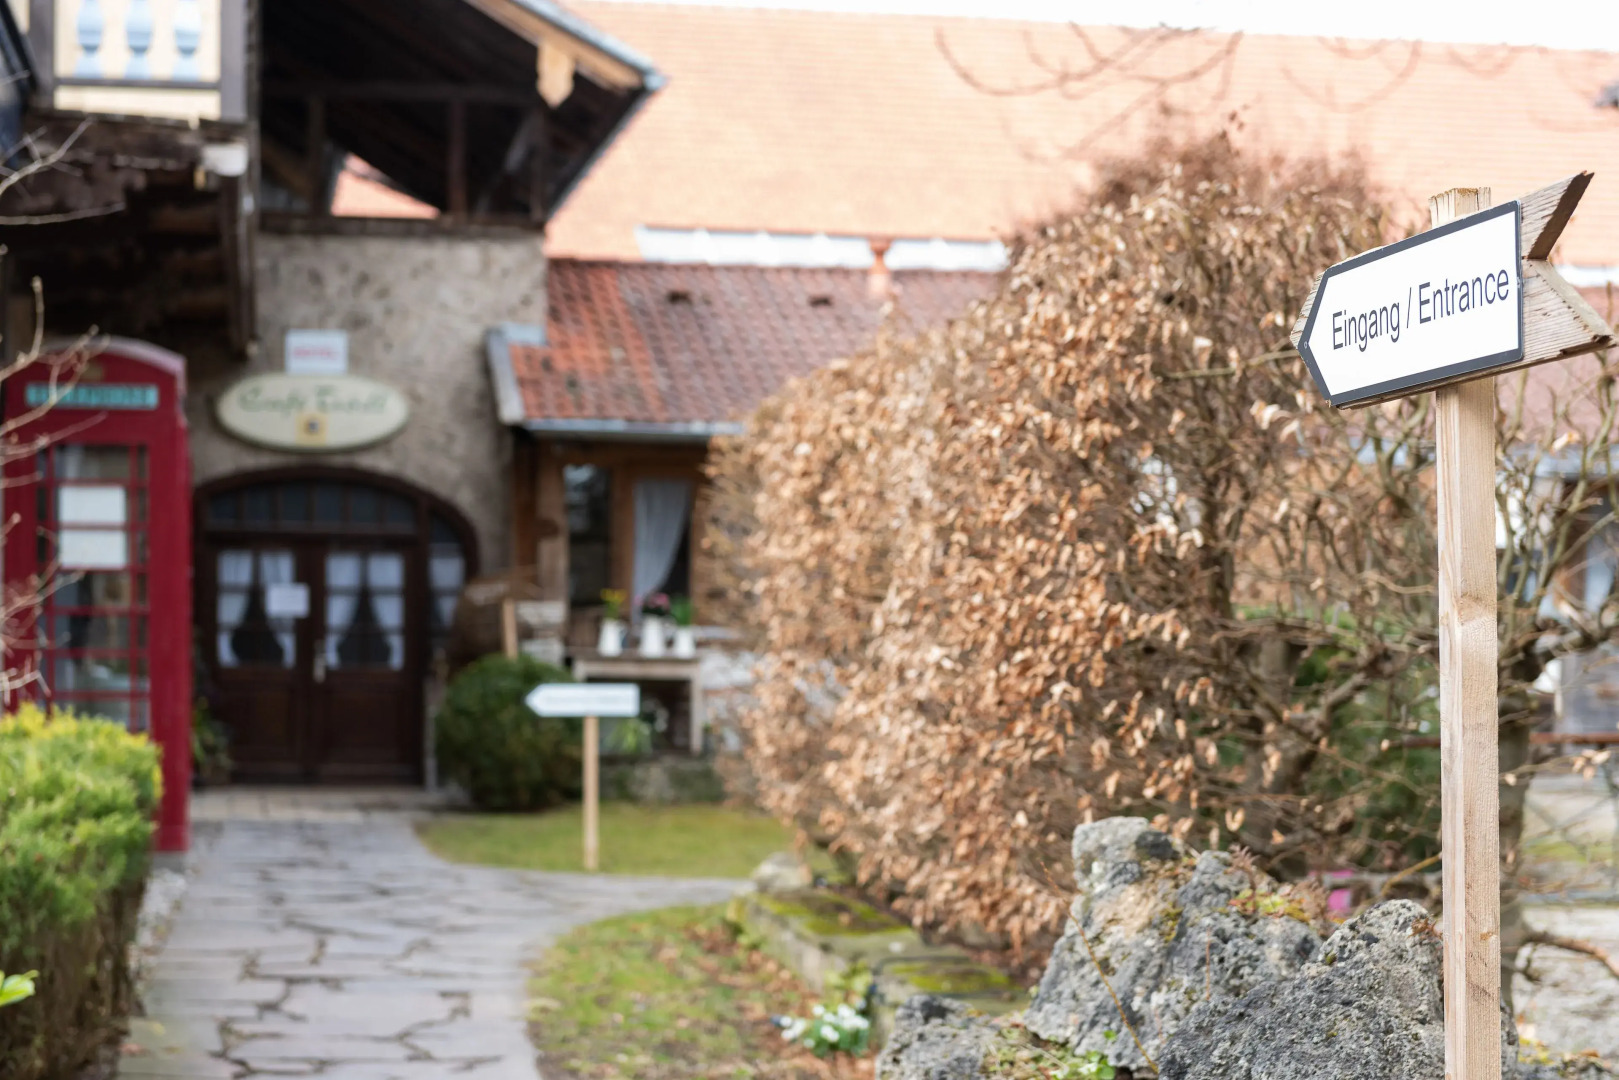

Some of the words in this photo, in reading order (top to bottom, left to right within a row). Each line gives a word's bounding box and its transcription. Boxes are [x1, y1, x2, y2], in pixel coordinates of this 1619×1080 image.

[1331, 301, 1400, 352] Eingang
[1405, 286, 1412, 329] /
[1418, 269, 1510, 324] Entrance
